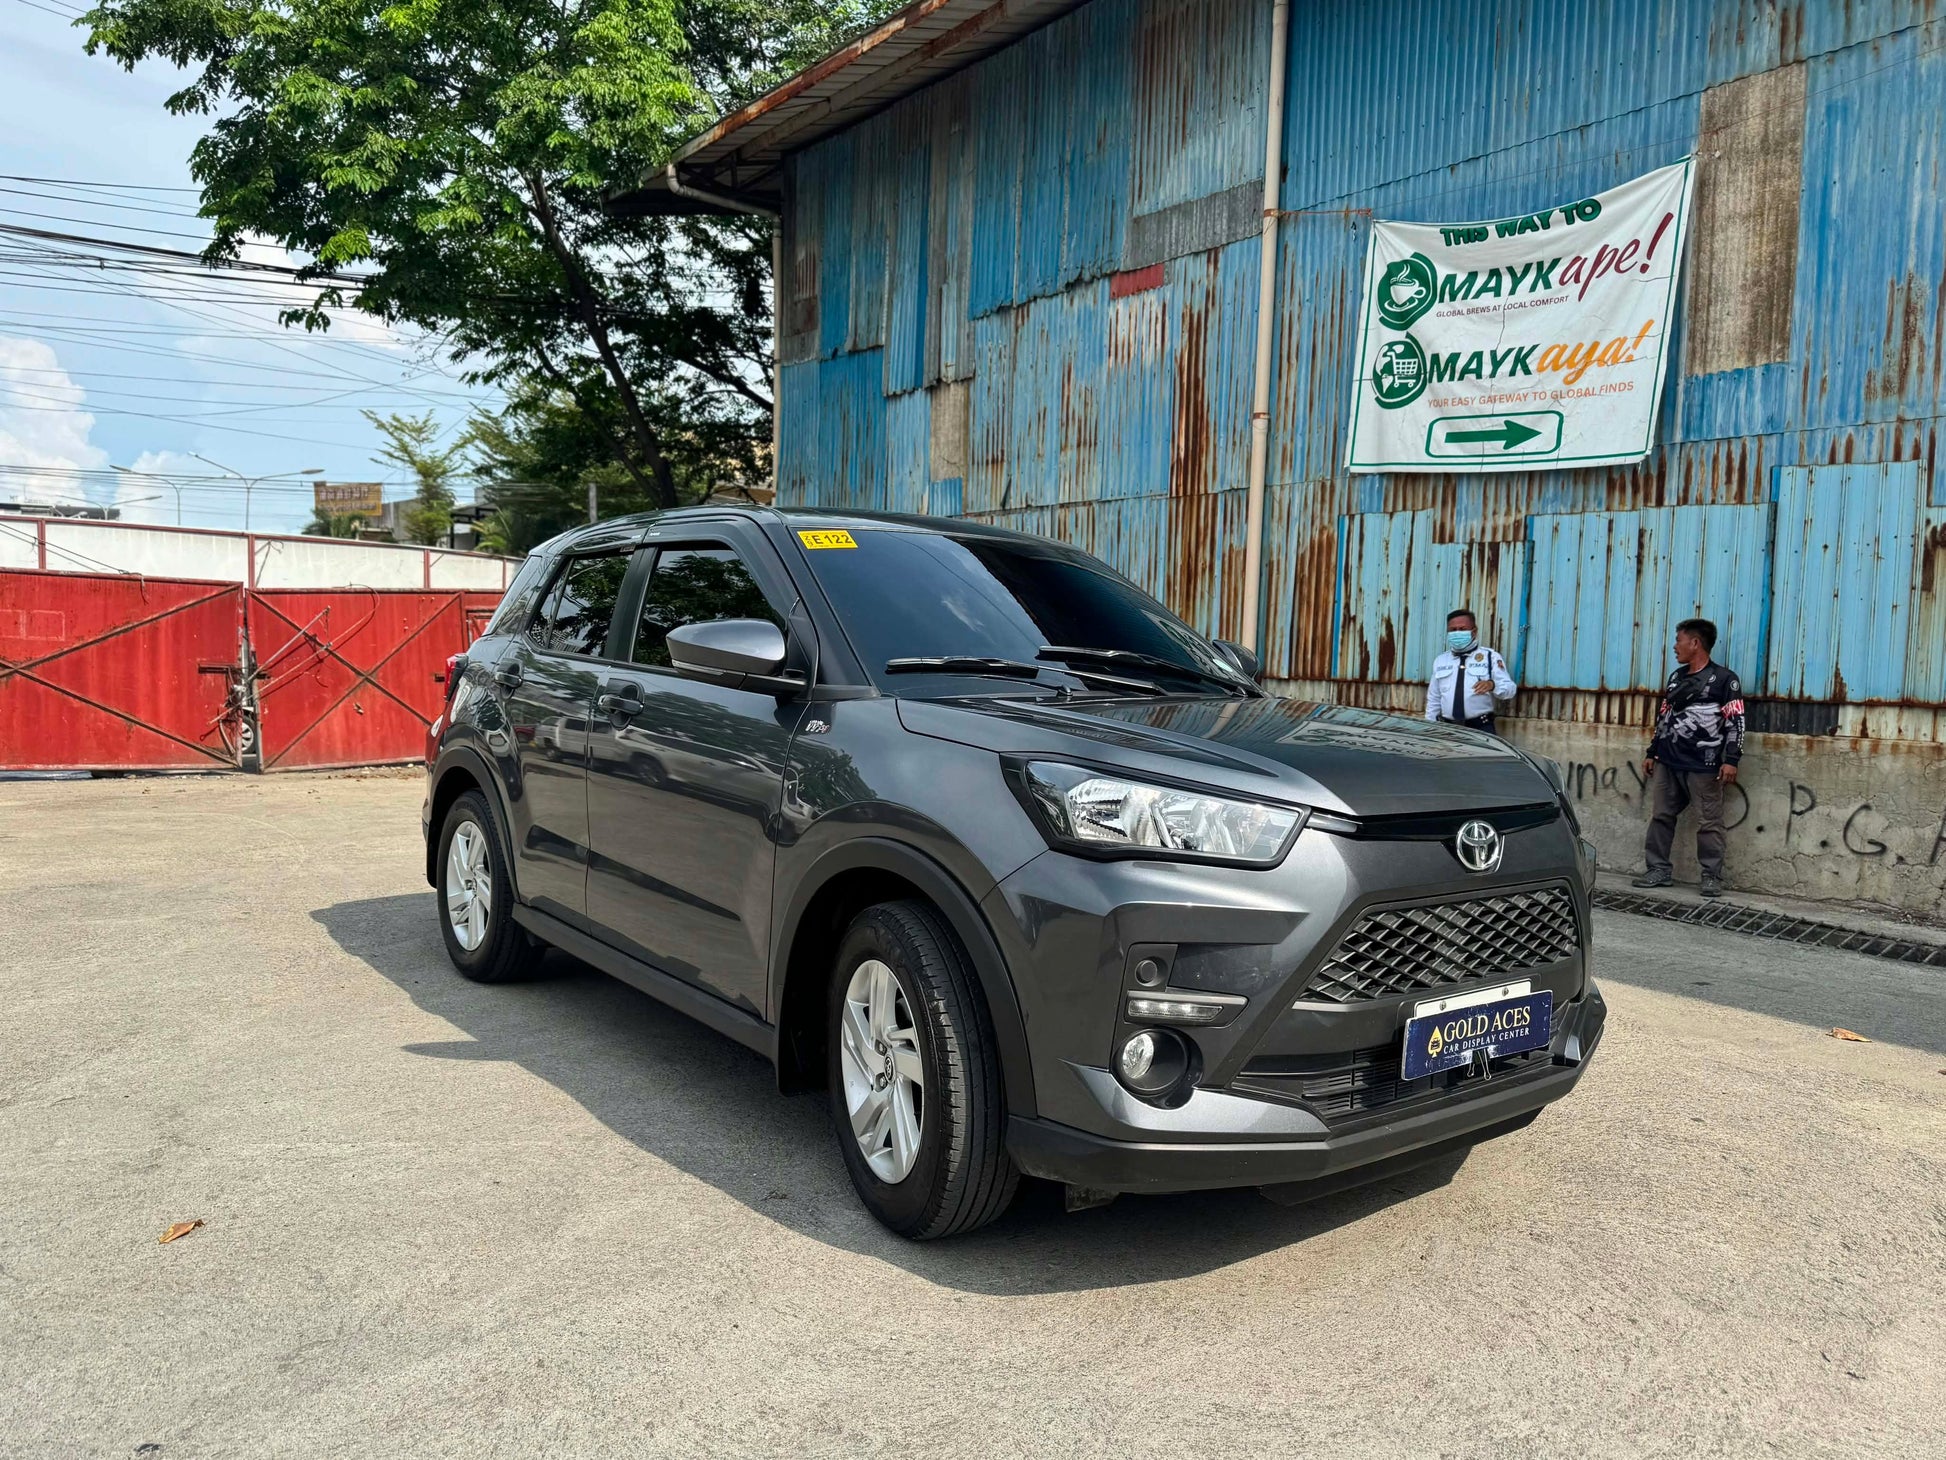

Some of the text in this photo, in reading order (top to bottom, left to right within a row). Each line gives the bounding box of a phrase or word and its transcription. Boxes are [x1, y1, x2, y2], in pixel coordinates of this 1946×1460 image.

[1440, 198, 1602, 246] THIS WAY TO
[1436, 295, 1569, 318] GLOBAL BREWS AT LOCAL COMFORT
[1428, 381, 1634, 408] YOUR EASY GATEWAY TO GLOBAL FINDS
[1443, 1005, 1531, 1043] GOLD ACES
[1443, 1027, 1530, 1054] CAR DISPLAY CENTER
